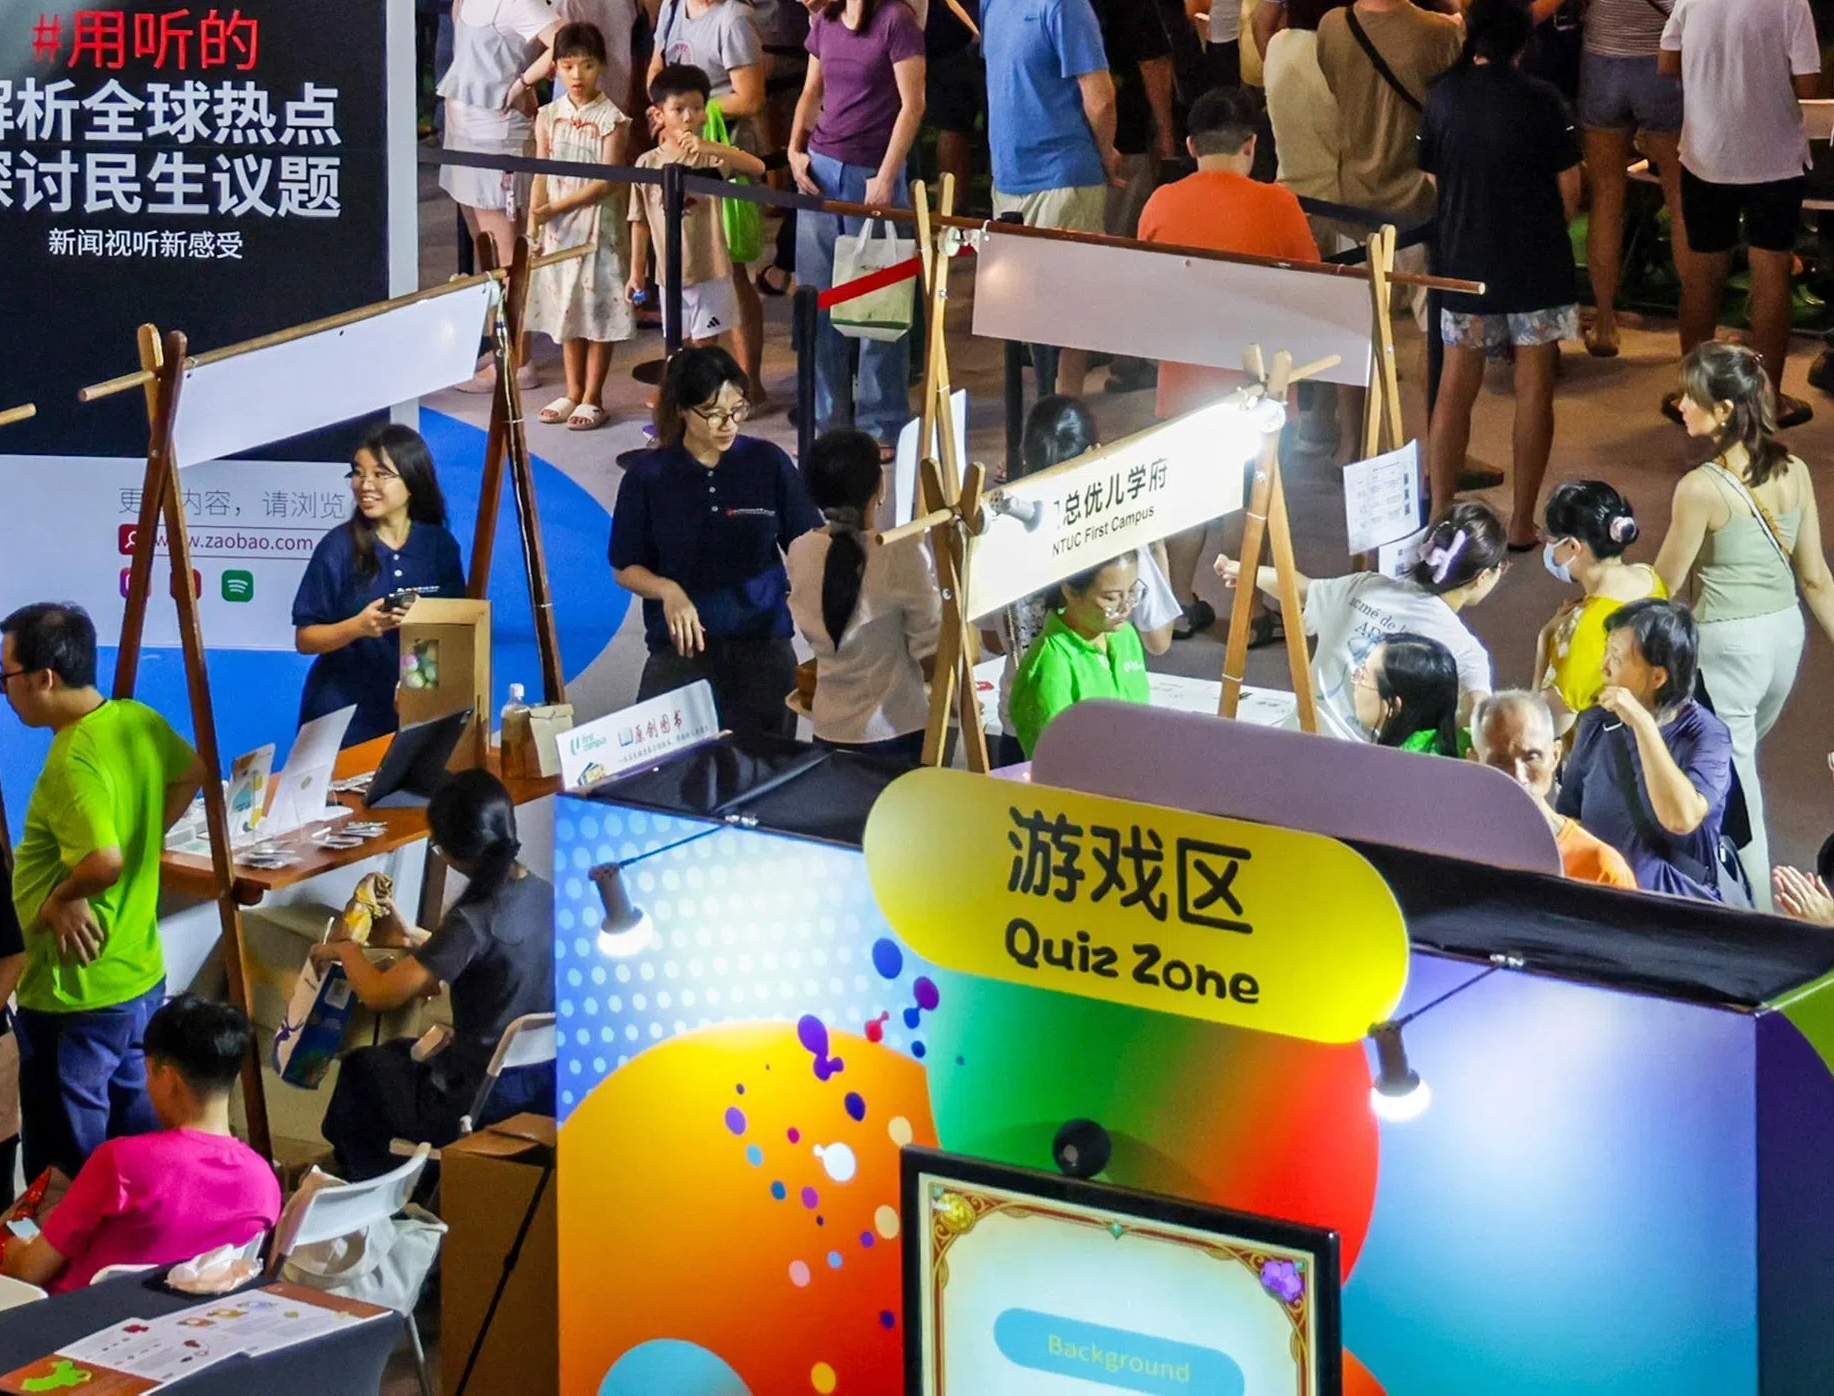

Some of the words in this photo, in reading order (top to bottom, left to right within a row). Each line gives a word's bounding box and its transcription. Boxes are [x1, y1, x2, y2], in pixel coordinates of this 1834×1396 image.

[30, 7, 260, 71] #用听的
[47, 227, 244, 260] 新闻视听新感受
[118, 488, 347, 520] 更内容，请浏览
[1053, 457, 1169, 530] 总优儿学府
[153, 530, 315, 553] ww.zaobao.com
[1051, 530, 1082, 557] NTUC
[1084, 522, 1109, 544] First
[1111, 505, 1155, 533] Campus
[634, 709, 684, 746] 原创图书
[1006, 805, 1254, 935] 游戏区
[1004, 917, 1119, 980] Quiz
[1130, 943, 1261, 1006] Zone
[1047, 1333, 1192, 1386] Background
